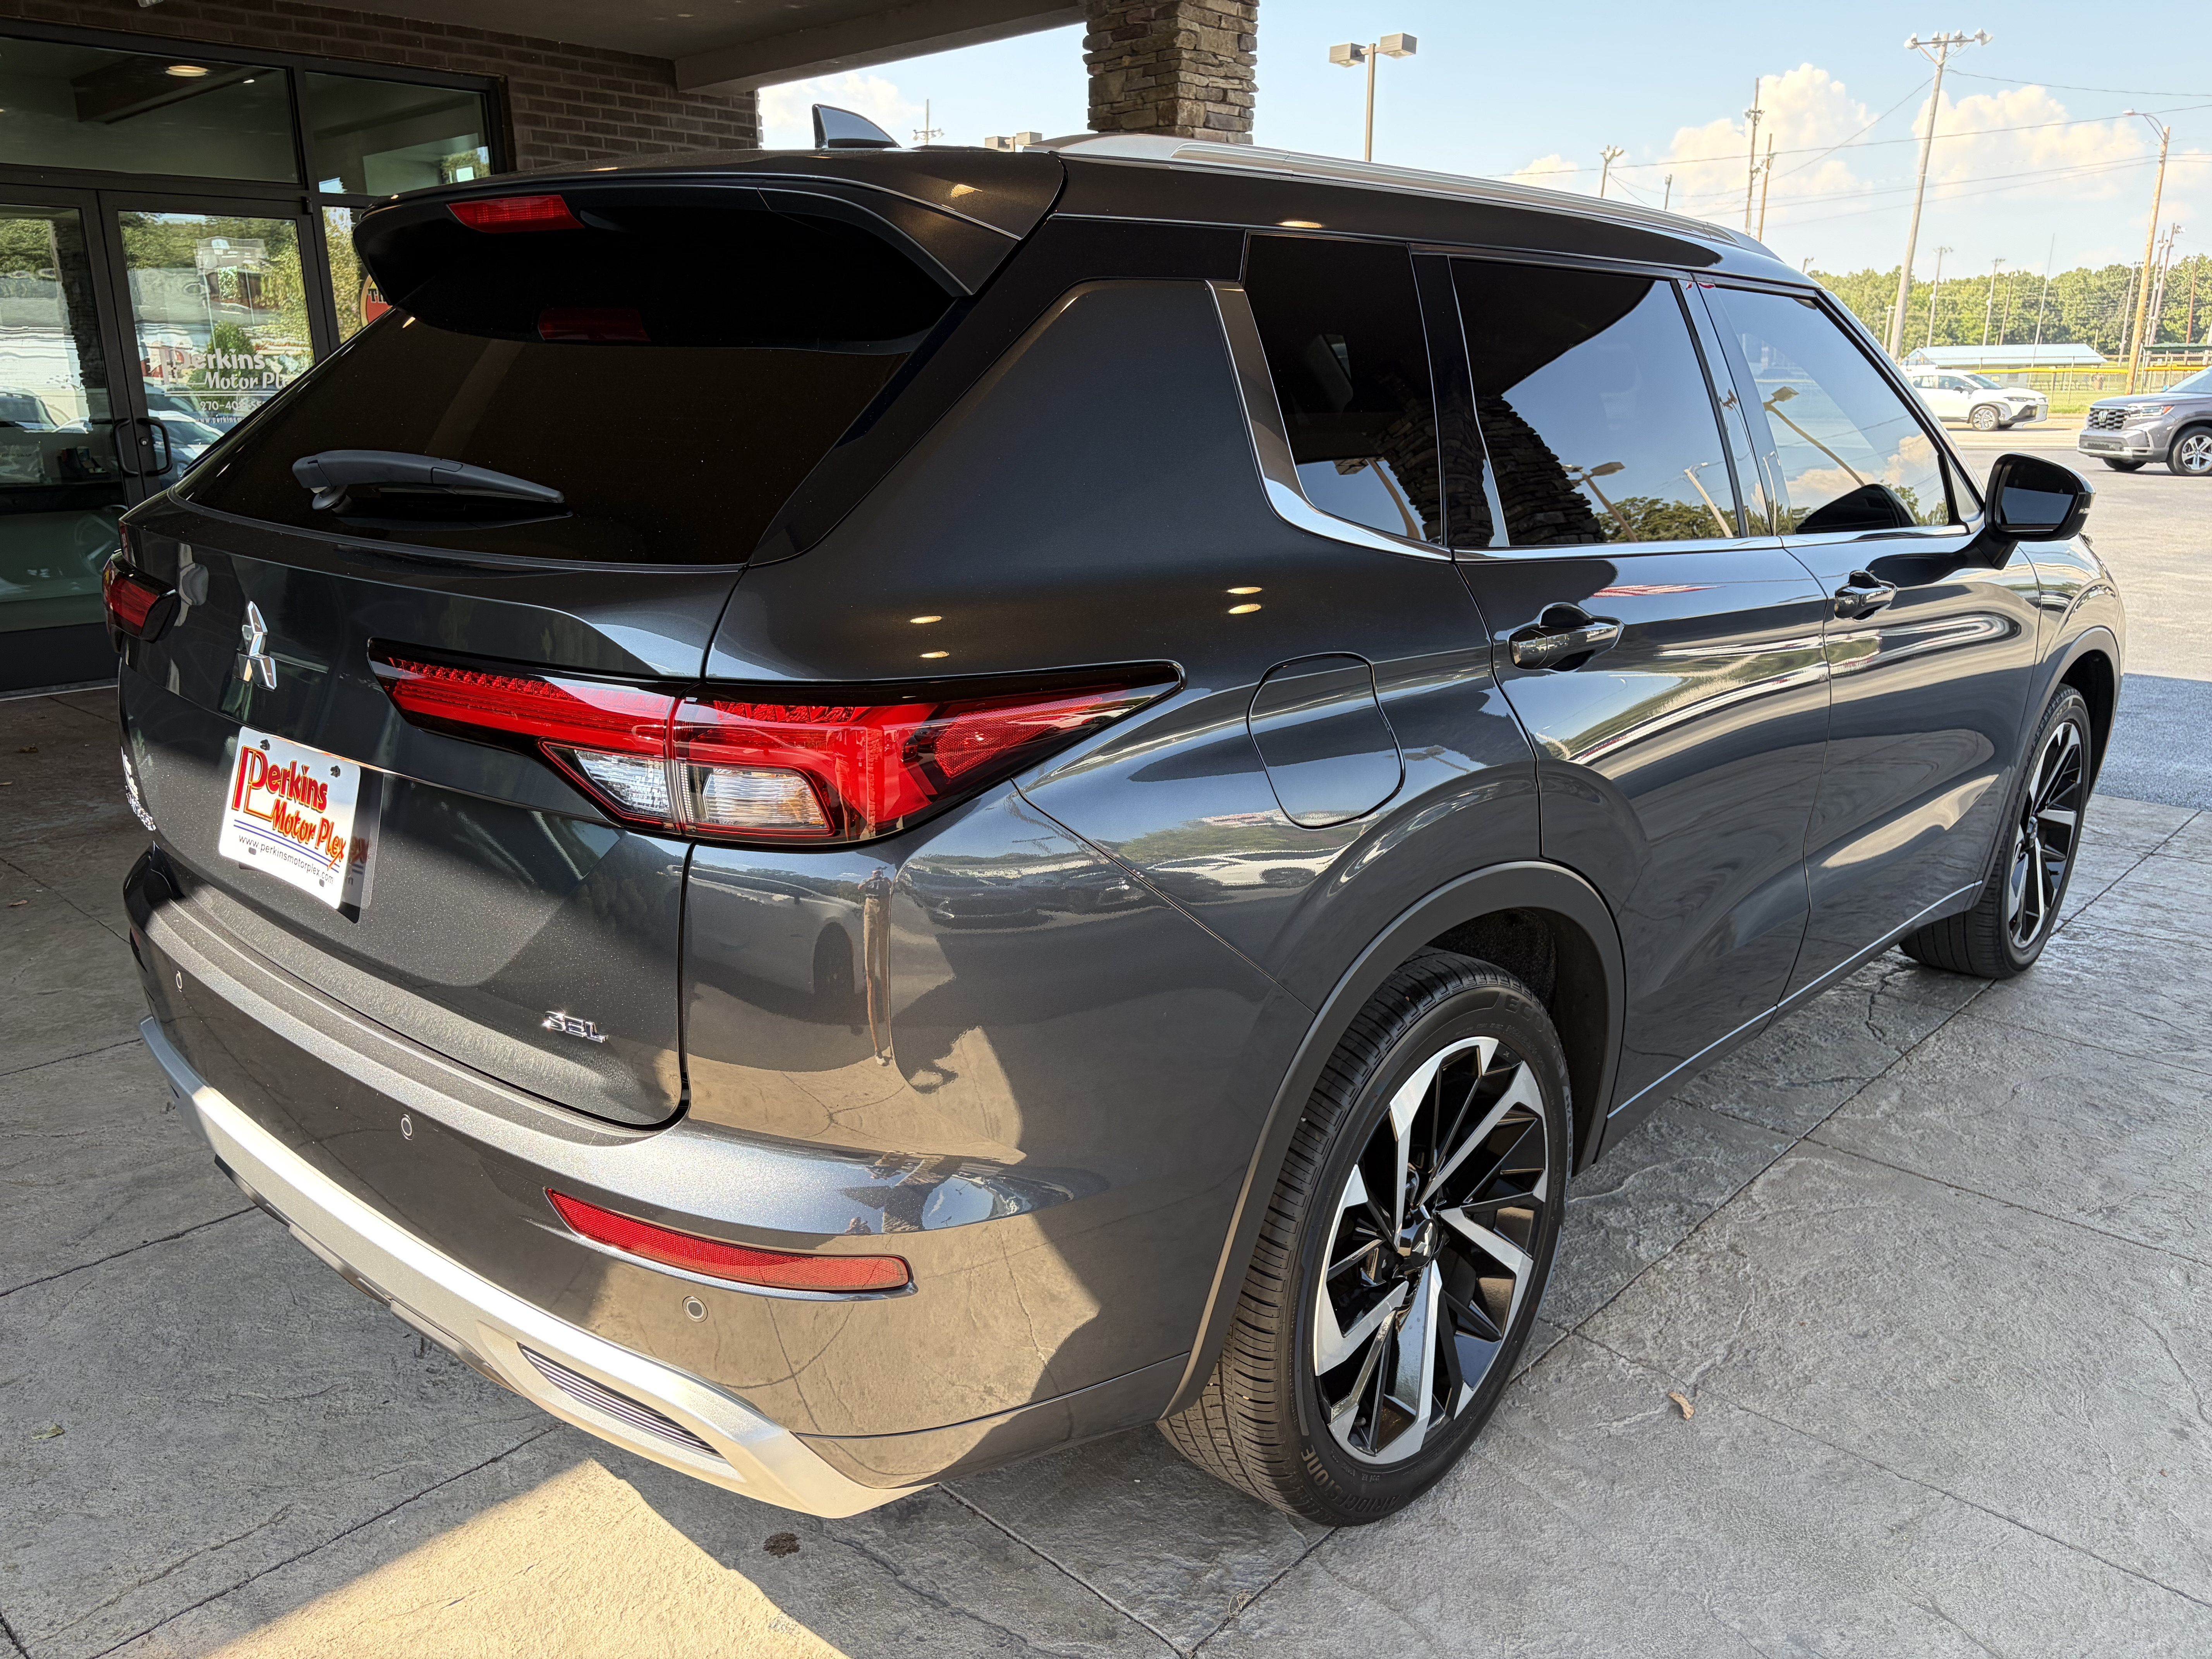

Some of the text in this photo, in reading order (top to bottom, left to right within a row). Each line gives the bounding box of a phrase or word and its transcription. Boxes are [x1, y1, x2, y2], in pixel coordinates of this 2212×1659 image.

[159, 346, 266, 385] Perkins
[205, 371, 289, 390] Motor Ple
[231, 745, 329, 813] Perkins
[270, 799, 316, 845] Motor
[315, 817, 346, 869] Plex
[239, 835, 334, 885] www.perkinsmotorplex.com
[543, 1010, 609, 1043] SEL
[1300, 1444, 1403, 1513] BRIDGESTONE
